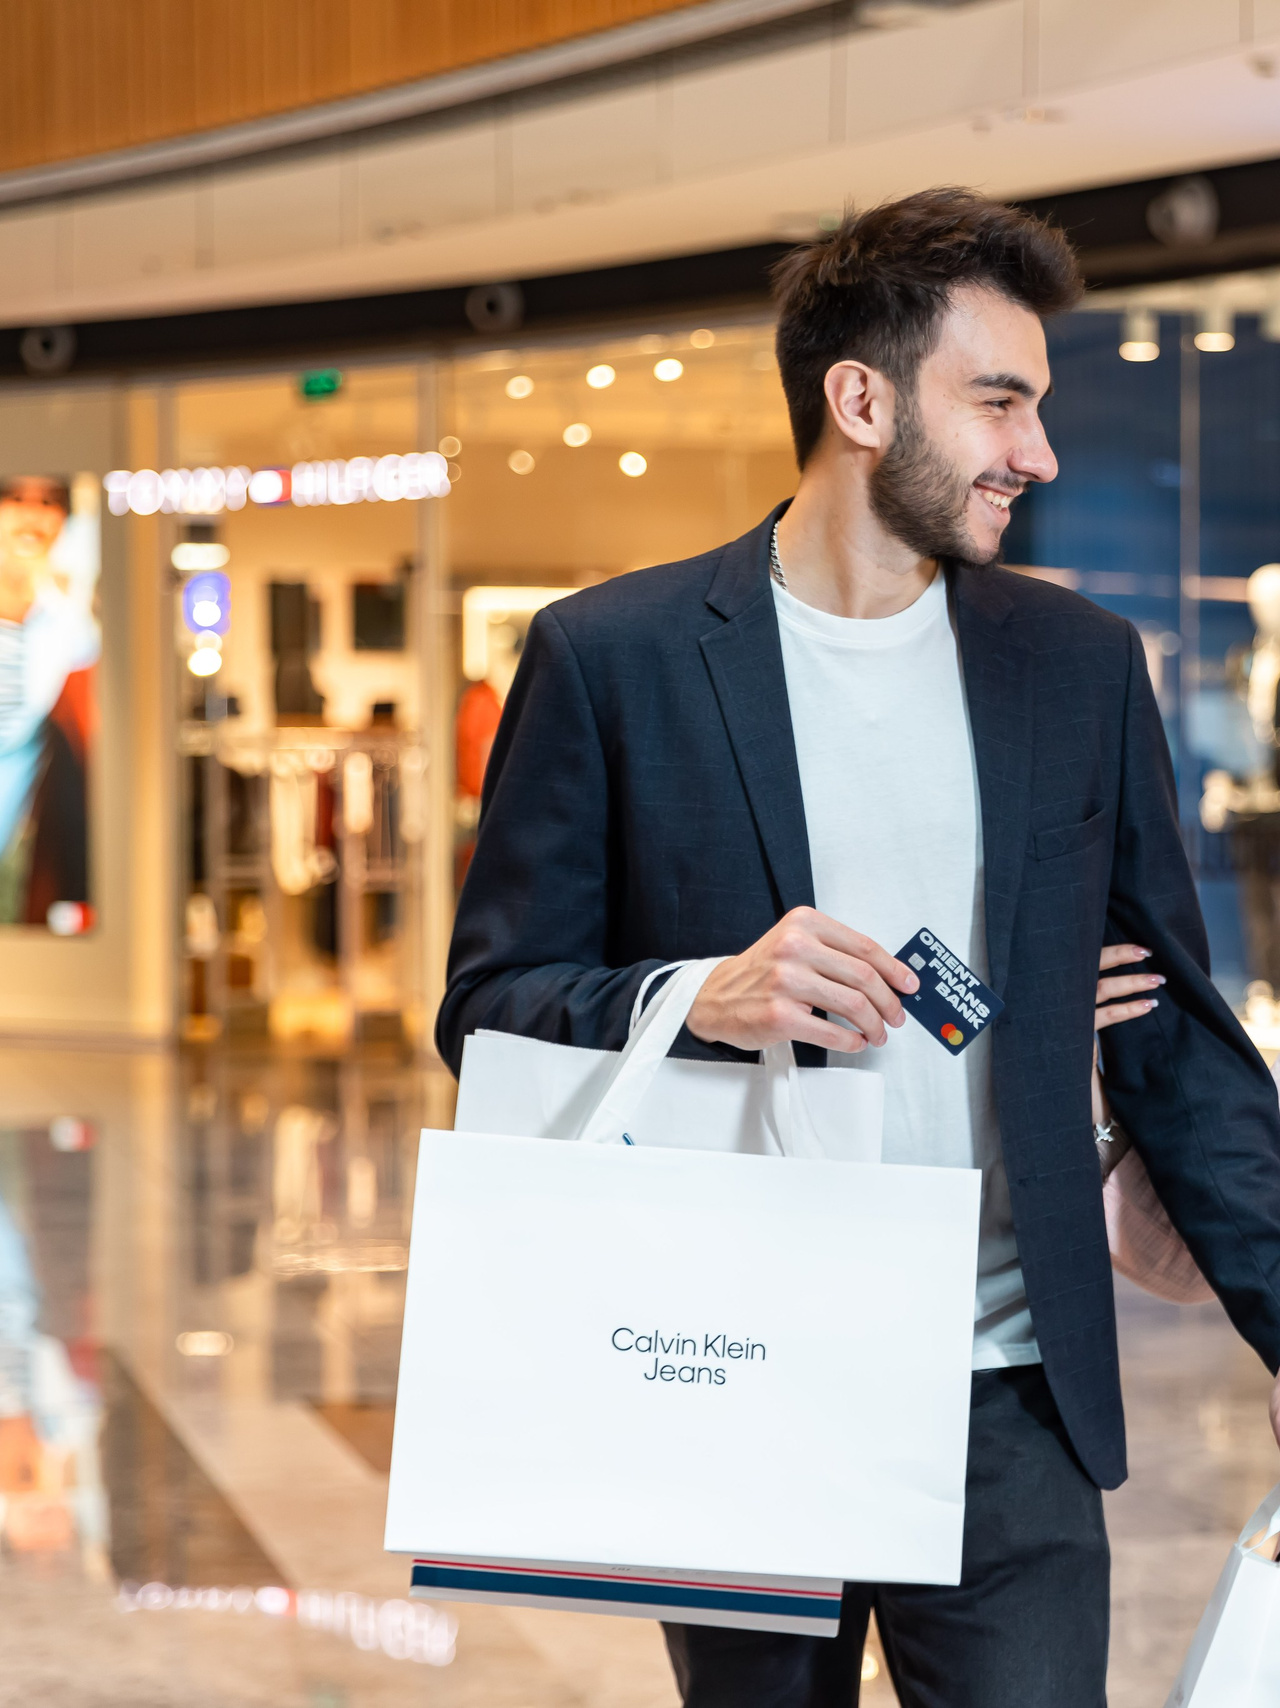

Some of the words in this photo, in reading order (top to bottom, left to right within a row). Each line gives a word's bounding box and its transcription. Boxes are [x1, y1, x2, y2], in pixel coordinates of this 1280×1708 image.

[919, 931, 980, 988] ORIENT
[928, 957, 990, 1018] FINANS
[934, 981, 984, 1030] BANK
[611, 1327, 697, 1356] Calvin
[703, 1333, 767, 1361] Klein
[643, 1357, 727, 1386] Jeans
